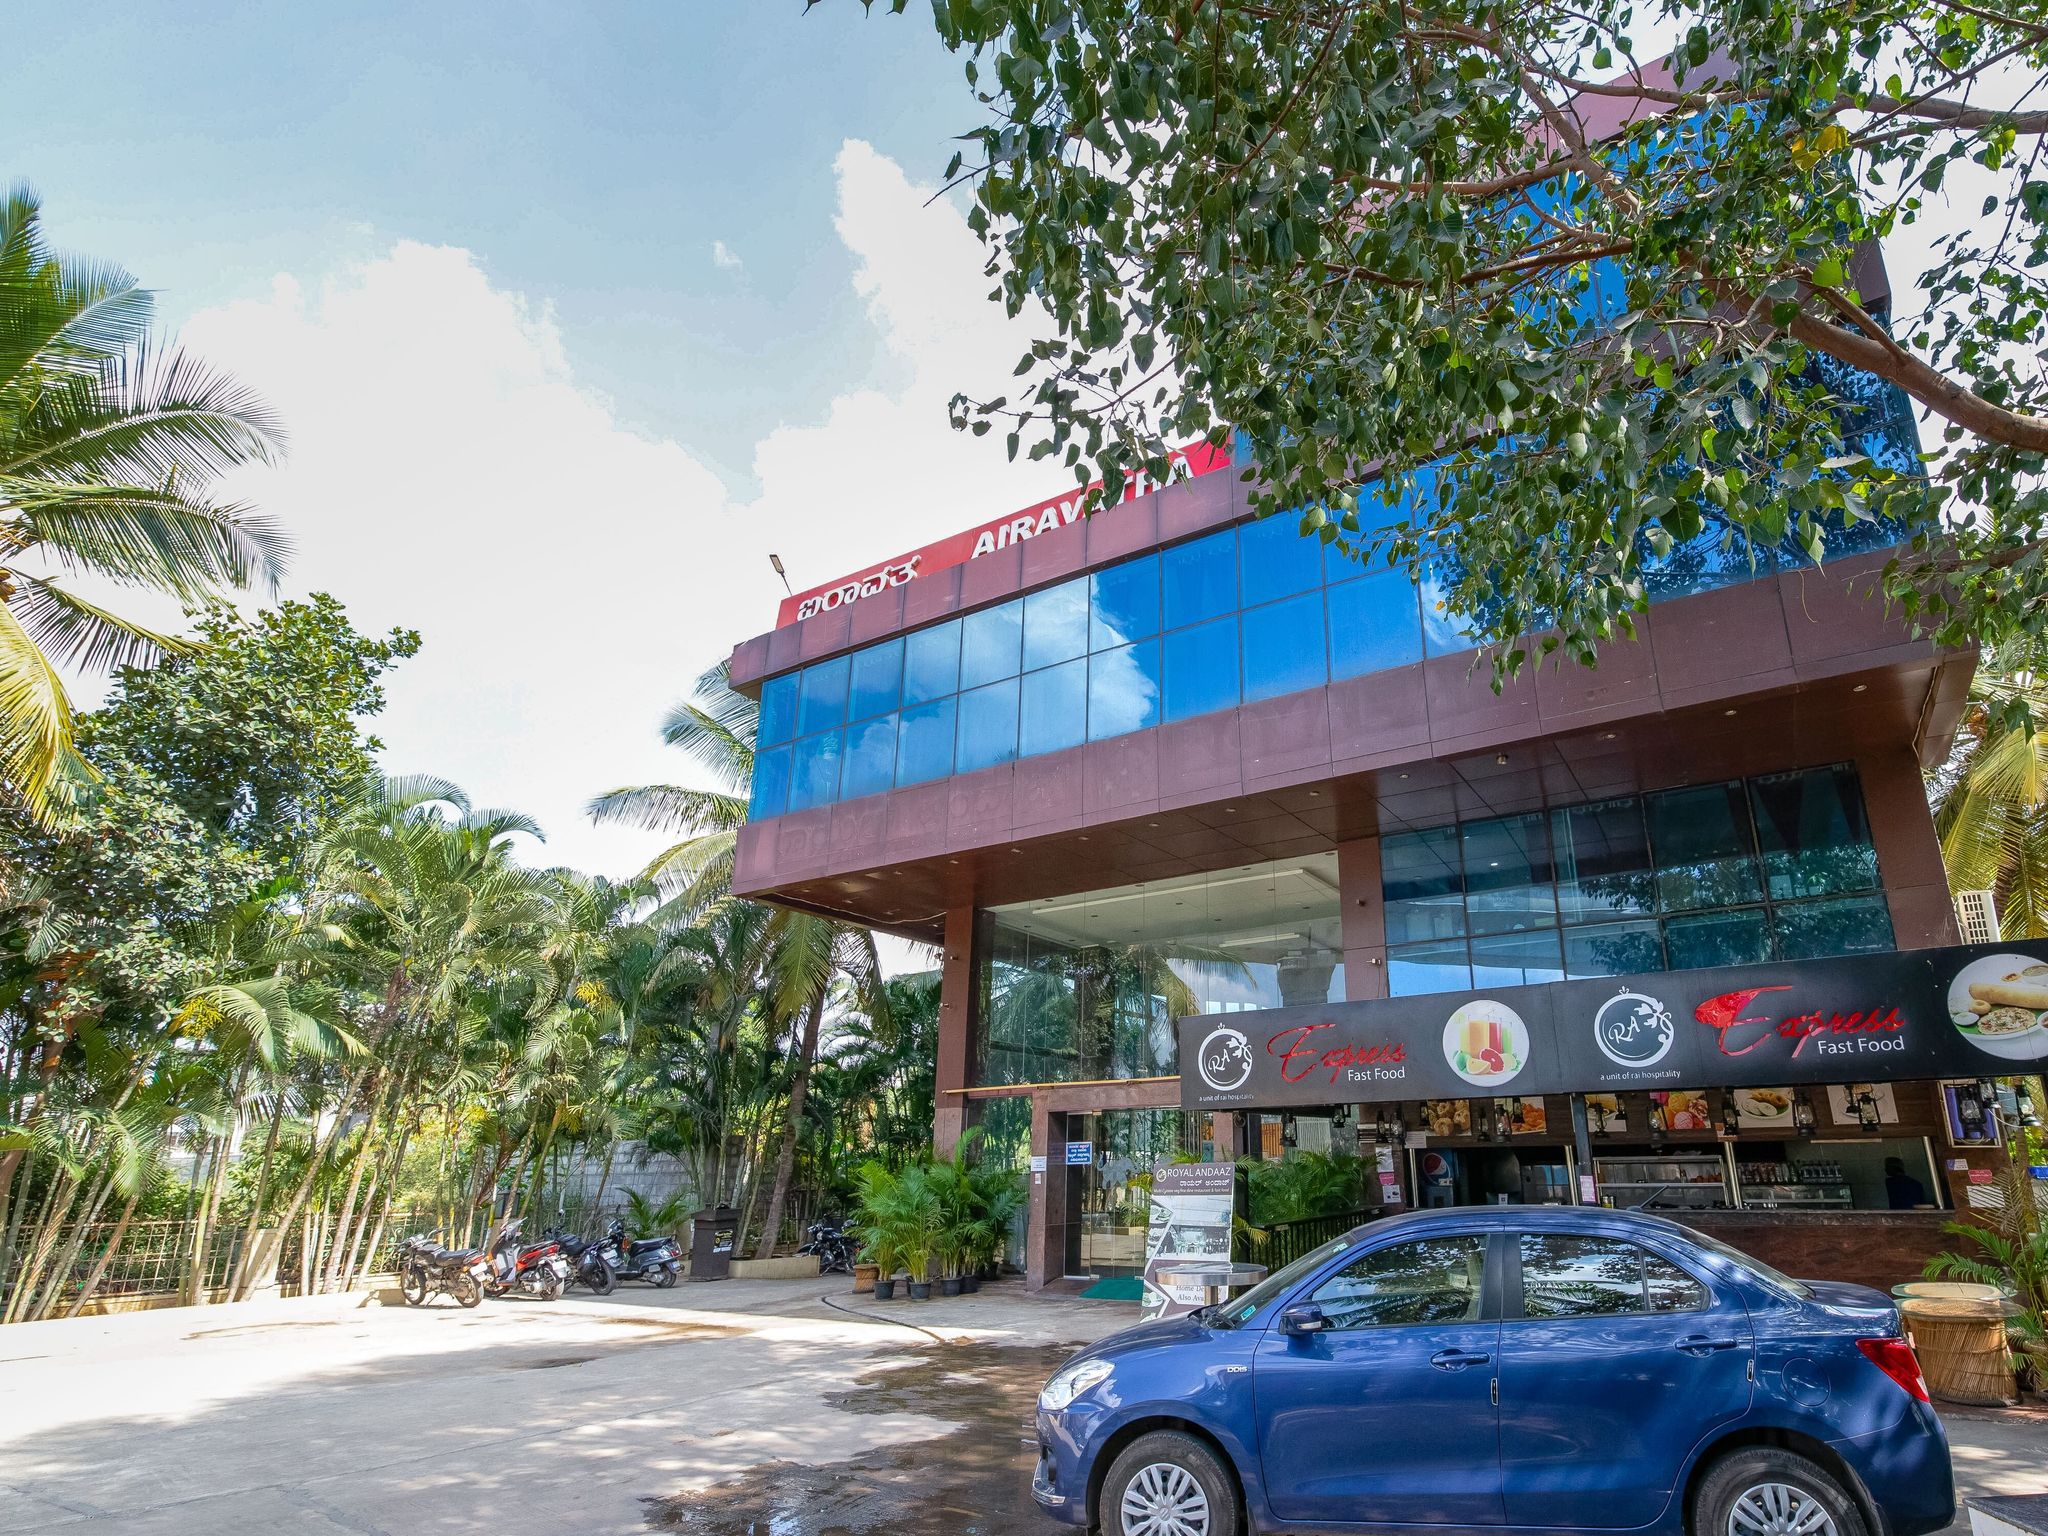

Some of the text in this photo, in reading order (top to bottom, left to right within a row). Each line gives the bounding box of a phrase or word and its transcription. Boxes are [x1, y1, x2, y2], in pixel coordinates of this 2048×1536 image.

[971, 456, 1195, 559] AIRAVHA
[1694, 985, 1905, 1058] Express
[1266, 1023, 1407, 1084] Express
[1818, 1035, 1905, 1054] Fast Food
[1347, 1066, 1405, 1081] Fast Food
[1622, 1071, 1630, 1079] of
[1631, 1071, 1640, 1079] rai
[1641, 1070, 1680, 1079] hospitality
[1167, 1167, 1231, 1177] ROYAL ANDAAZ
